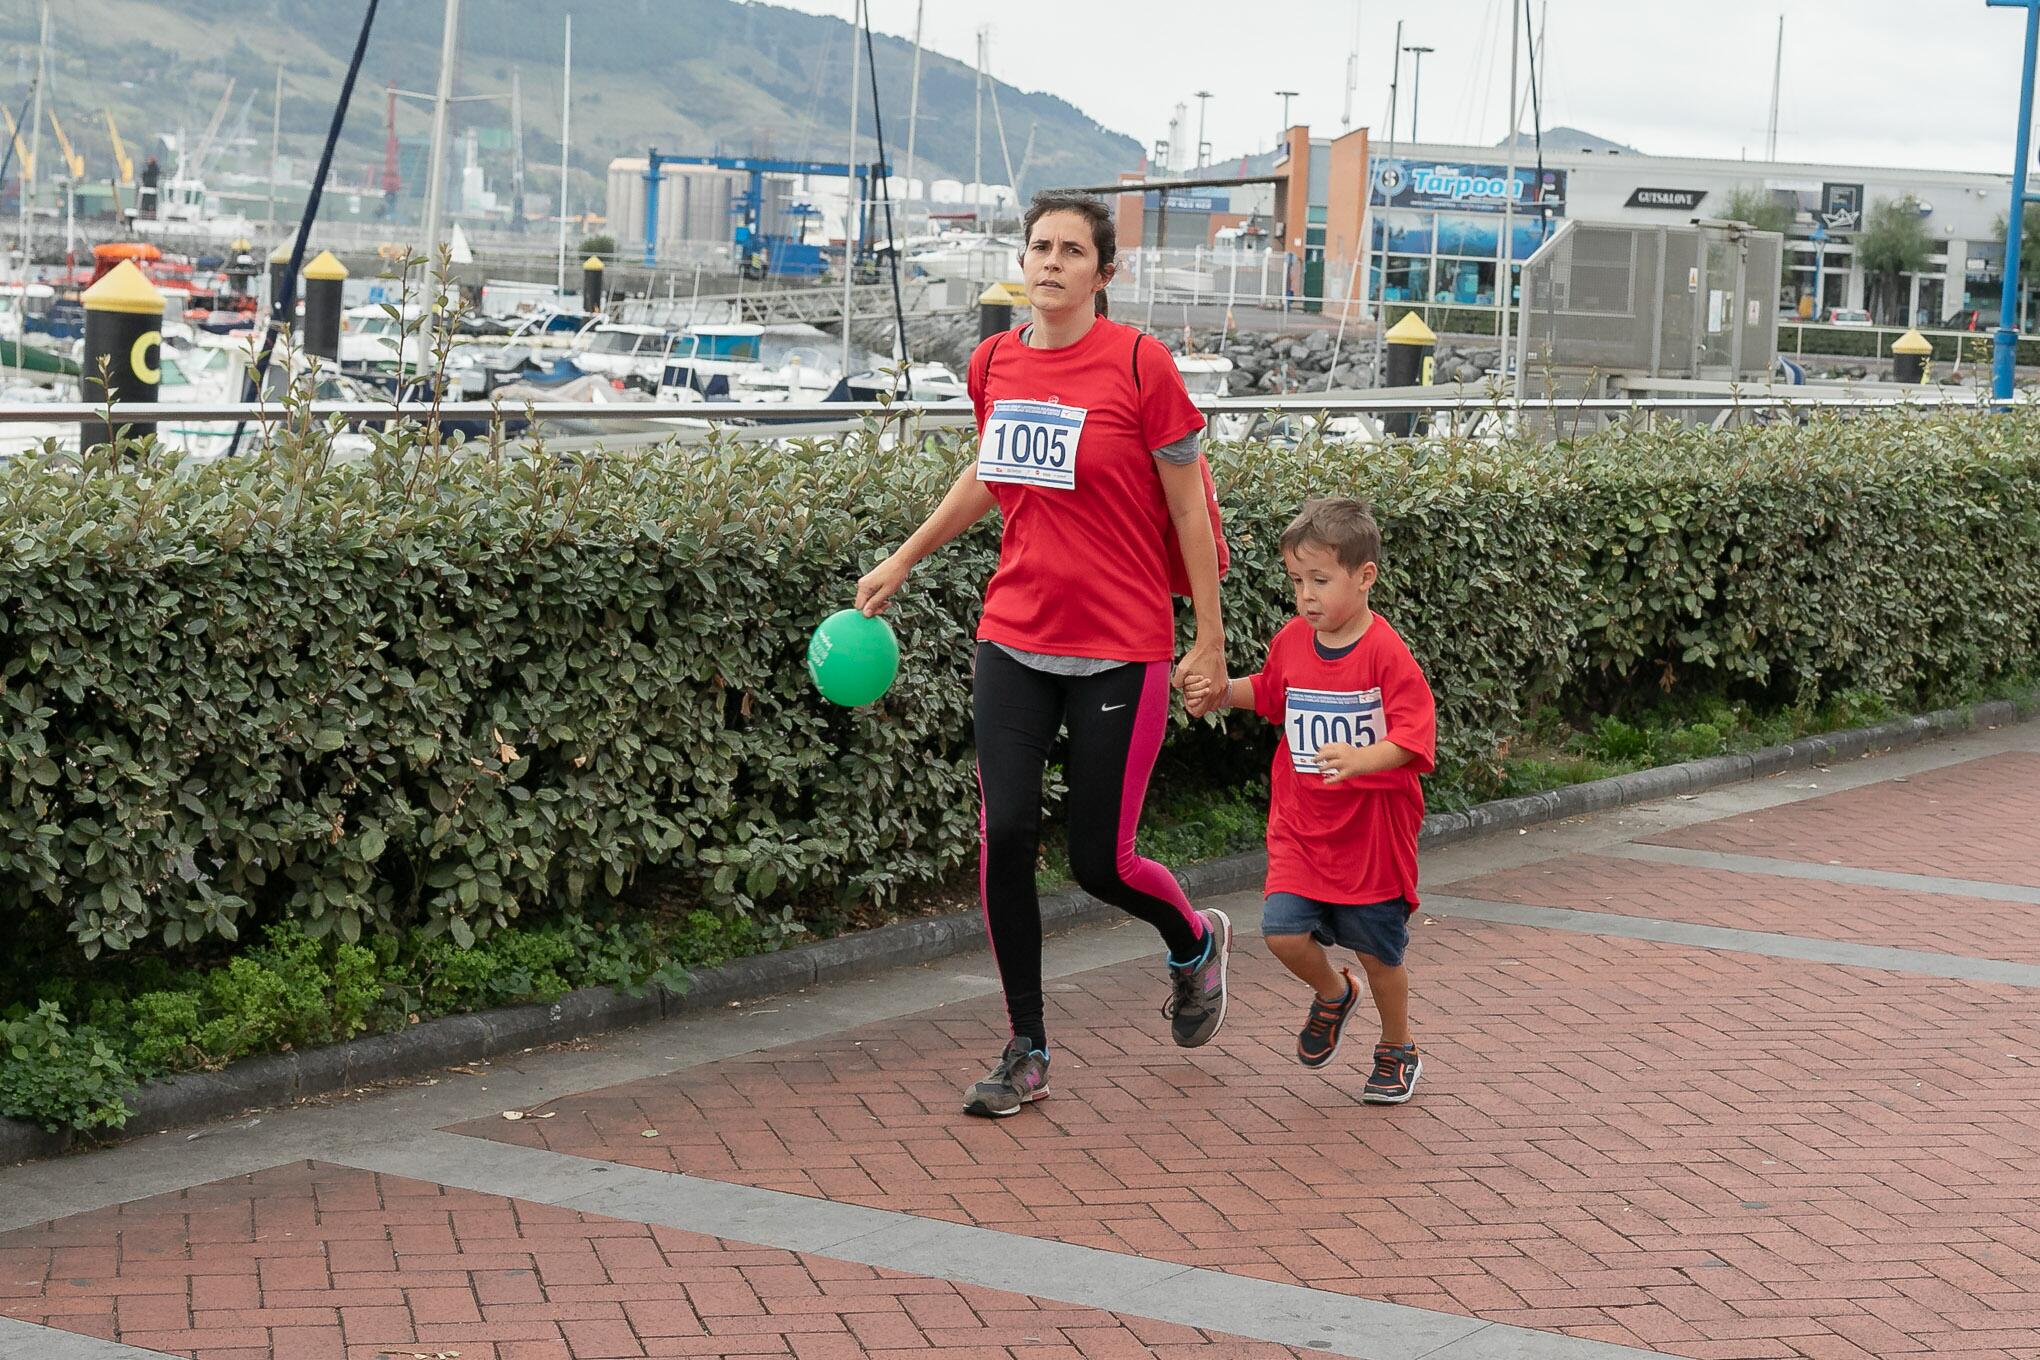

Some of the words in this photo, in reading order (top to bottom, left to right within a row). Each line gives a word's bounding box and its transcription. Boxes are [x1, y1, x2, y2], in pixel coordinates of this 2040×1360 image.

[1413, 169, 1523, 199] Tarpoon
[994, 423, 1069, 468] 1005
[1293, 713, 1376, 752] 1005
